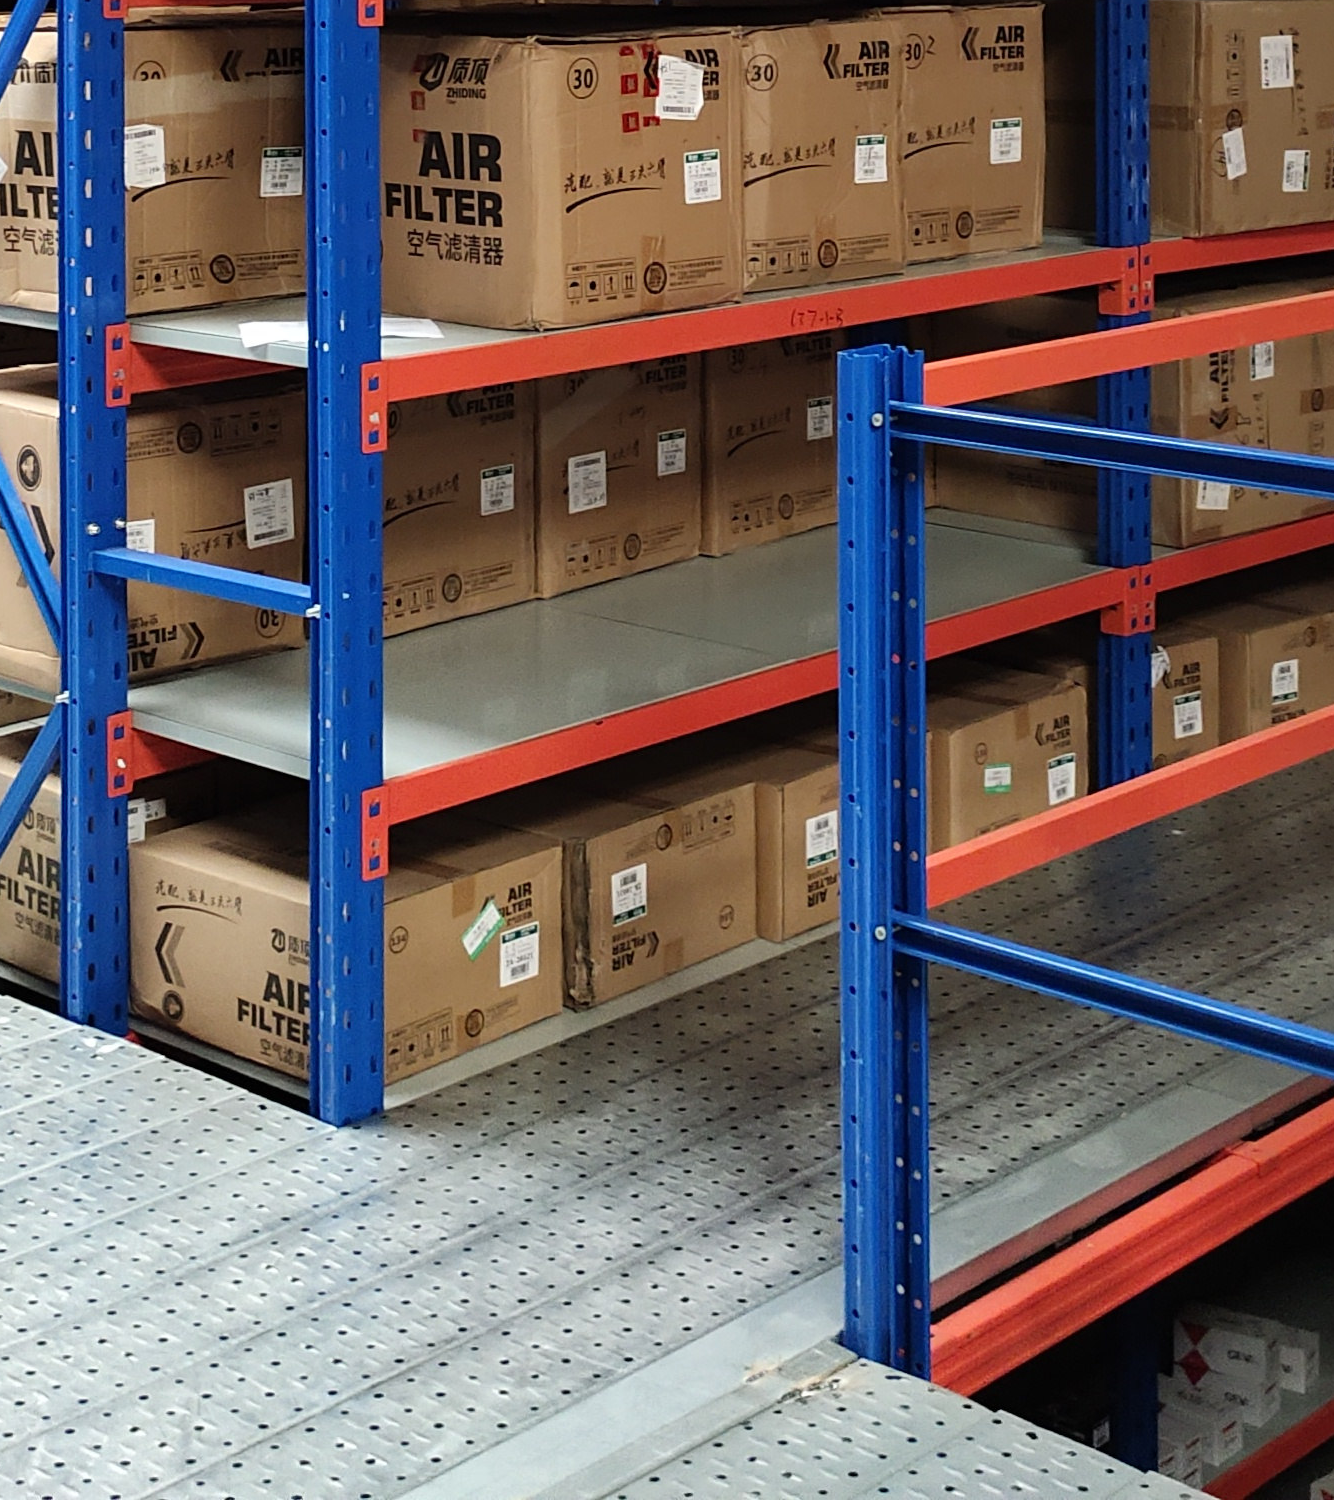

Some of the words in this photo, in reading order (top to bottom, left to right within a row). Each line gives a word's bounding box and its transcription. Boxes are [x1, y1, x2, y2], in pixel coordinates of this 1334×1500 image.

[995, 25, 1025, 43] AIR
[858, 41, 889, 60] AIR
[904, 42, 922, 61] 30
[980, 45, 1025, 60] FILTER
[447, 57, 490, 86] 质顶
[572, 68, 593, 89] 30
[750, 64, 774, 82] 30
[843, 61, 889, 79] FILTER
[446, 87, 487, 100] ZHIDING
[13, 130, 57, 178] AI
[418, 130, 502, 182] AIR
[385, 182, 504, 228] FILTER
[407, 229, 504, 266] 空气滤清器
[794, 338, 833, 356] FILTER
[644, 365, 687, 385] FILTER
[466, 395, 514, 414] FILTER
[127, 625, 177, 647] FILTE
[127, 647, 158, 669] AI
[1182, 662, 1200, 675] AIR
[1174, 675, 1200, 688] FILTER
[1053, 715, 1070, 731] AIR
[17, 847, 61, 886] AIR
[508, 882, 532, 903] AIR
[808, 889, 827, 908] AIR
[612, 934, 646, 955] FILTER
[612, 951, 635, 971] AIR
